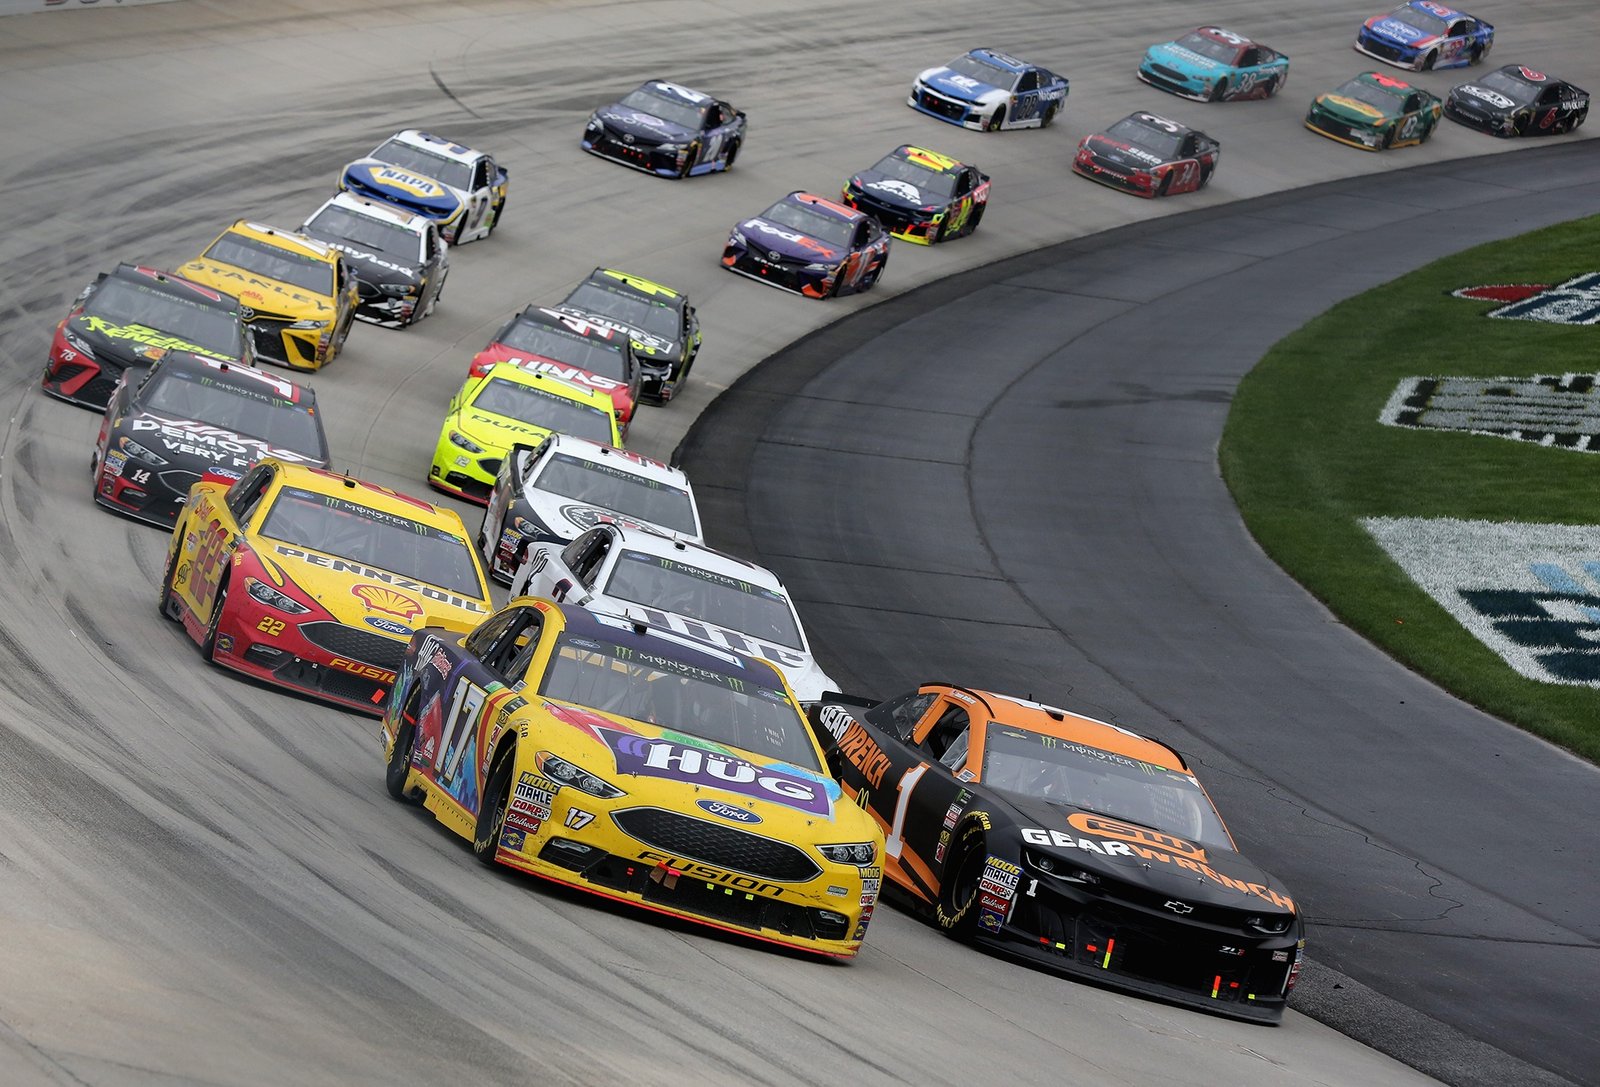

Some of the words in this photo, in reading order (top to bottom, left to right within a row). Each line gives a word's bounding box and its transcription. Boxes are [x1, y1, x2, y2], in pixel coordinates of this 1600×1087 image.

[381, 169, 435, 194] NAPA
[744, 219, 837, 259] FedEx
[310, 238, 415, 280] ithfield
[187, 262, 332, 311] STANLEY
[59, 348, 77, 361] 78
[629, 338, 657, 355] OS
[216, 382, 269, 402] MONSTER
[133, 419, 248, 454] DEMO
[162, 438, 227, 462] VERY
[131, 469, 151, 484] 14
[597, 465, 646, 483] MONSTER
[344, 502, 410, 528] MONSTER
[275, 545, 489, 615] PENNZOIL
[677, 563, 735, 587] MONSTER
[256, 616, 286, 637] 22
[374, 617, 406, 634] Ford
[639, 652, 723, 683] MONSTER
[434, 676, 488, 784] 17
[1062, 742, 1136, 769] MONSTER
[521, 773, 560, 793] MOOG
[516, 786, 553, 805] MAHLE
[512, 799, 543, 814] COMP
[710, 802, 749, 822] Ford
[886, 762, 931, 859] 1
[506, 813, 540, 832] Edelbrock
[565, 807, 596, 831] 17
[636, 851, 788, 897] FUSION
[860, 867, 880, 878] MOOG
[984, 865, 1019, 887] MAHLE
[986, 857, 1021, 875] MOOG
[981, 880, 1005, 895] COMP
[1026, 879, 1039, 898] 1
[981, 895, 1006, 912] Edelbrock
